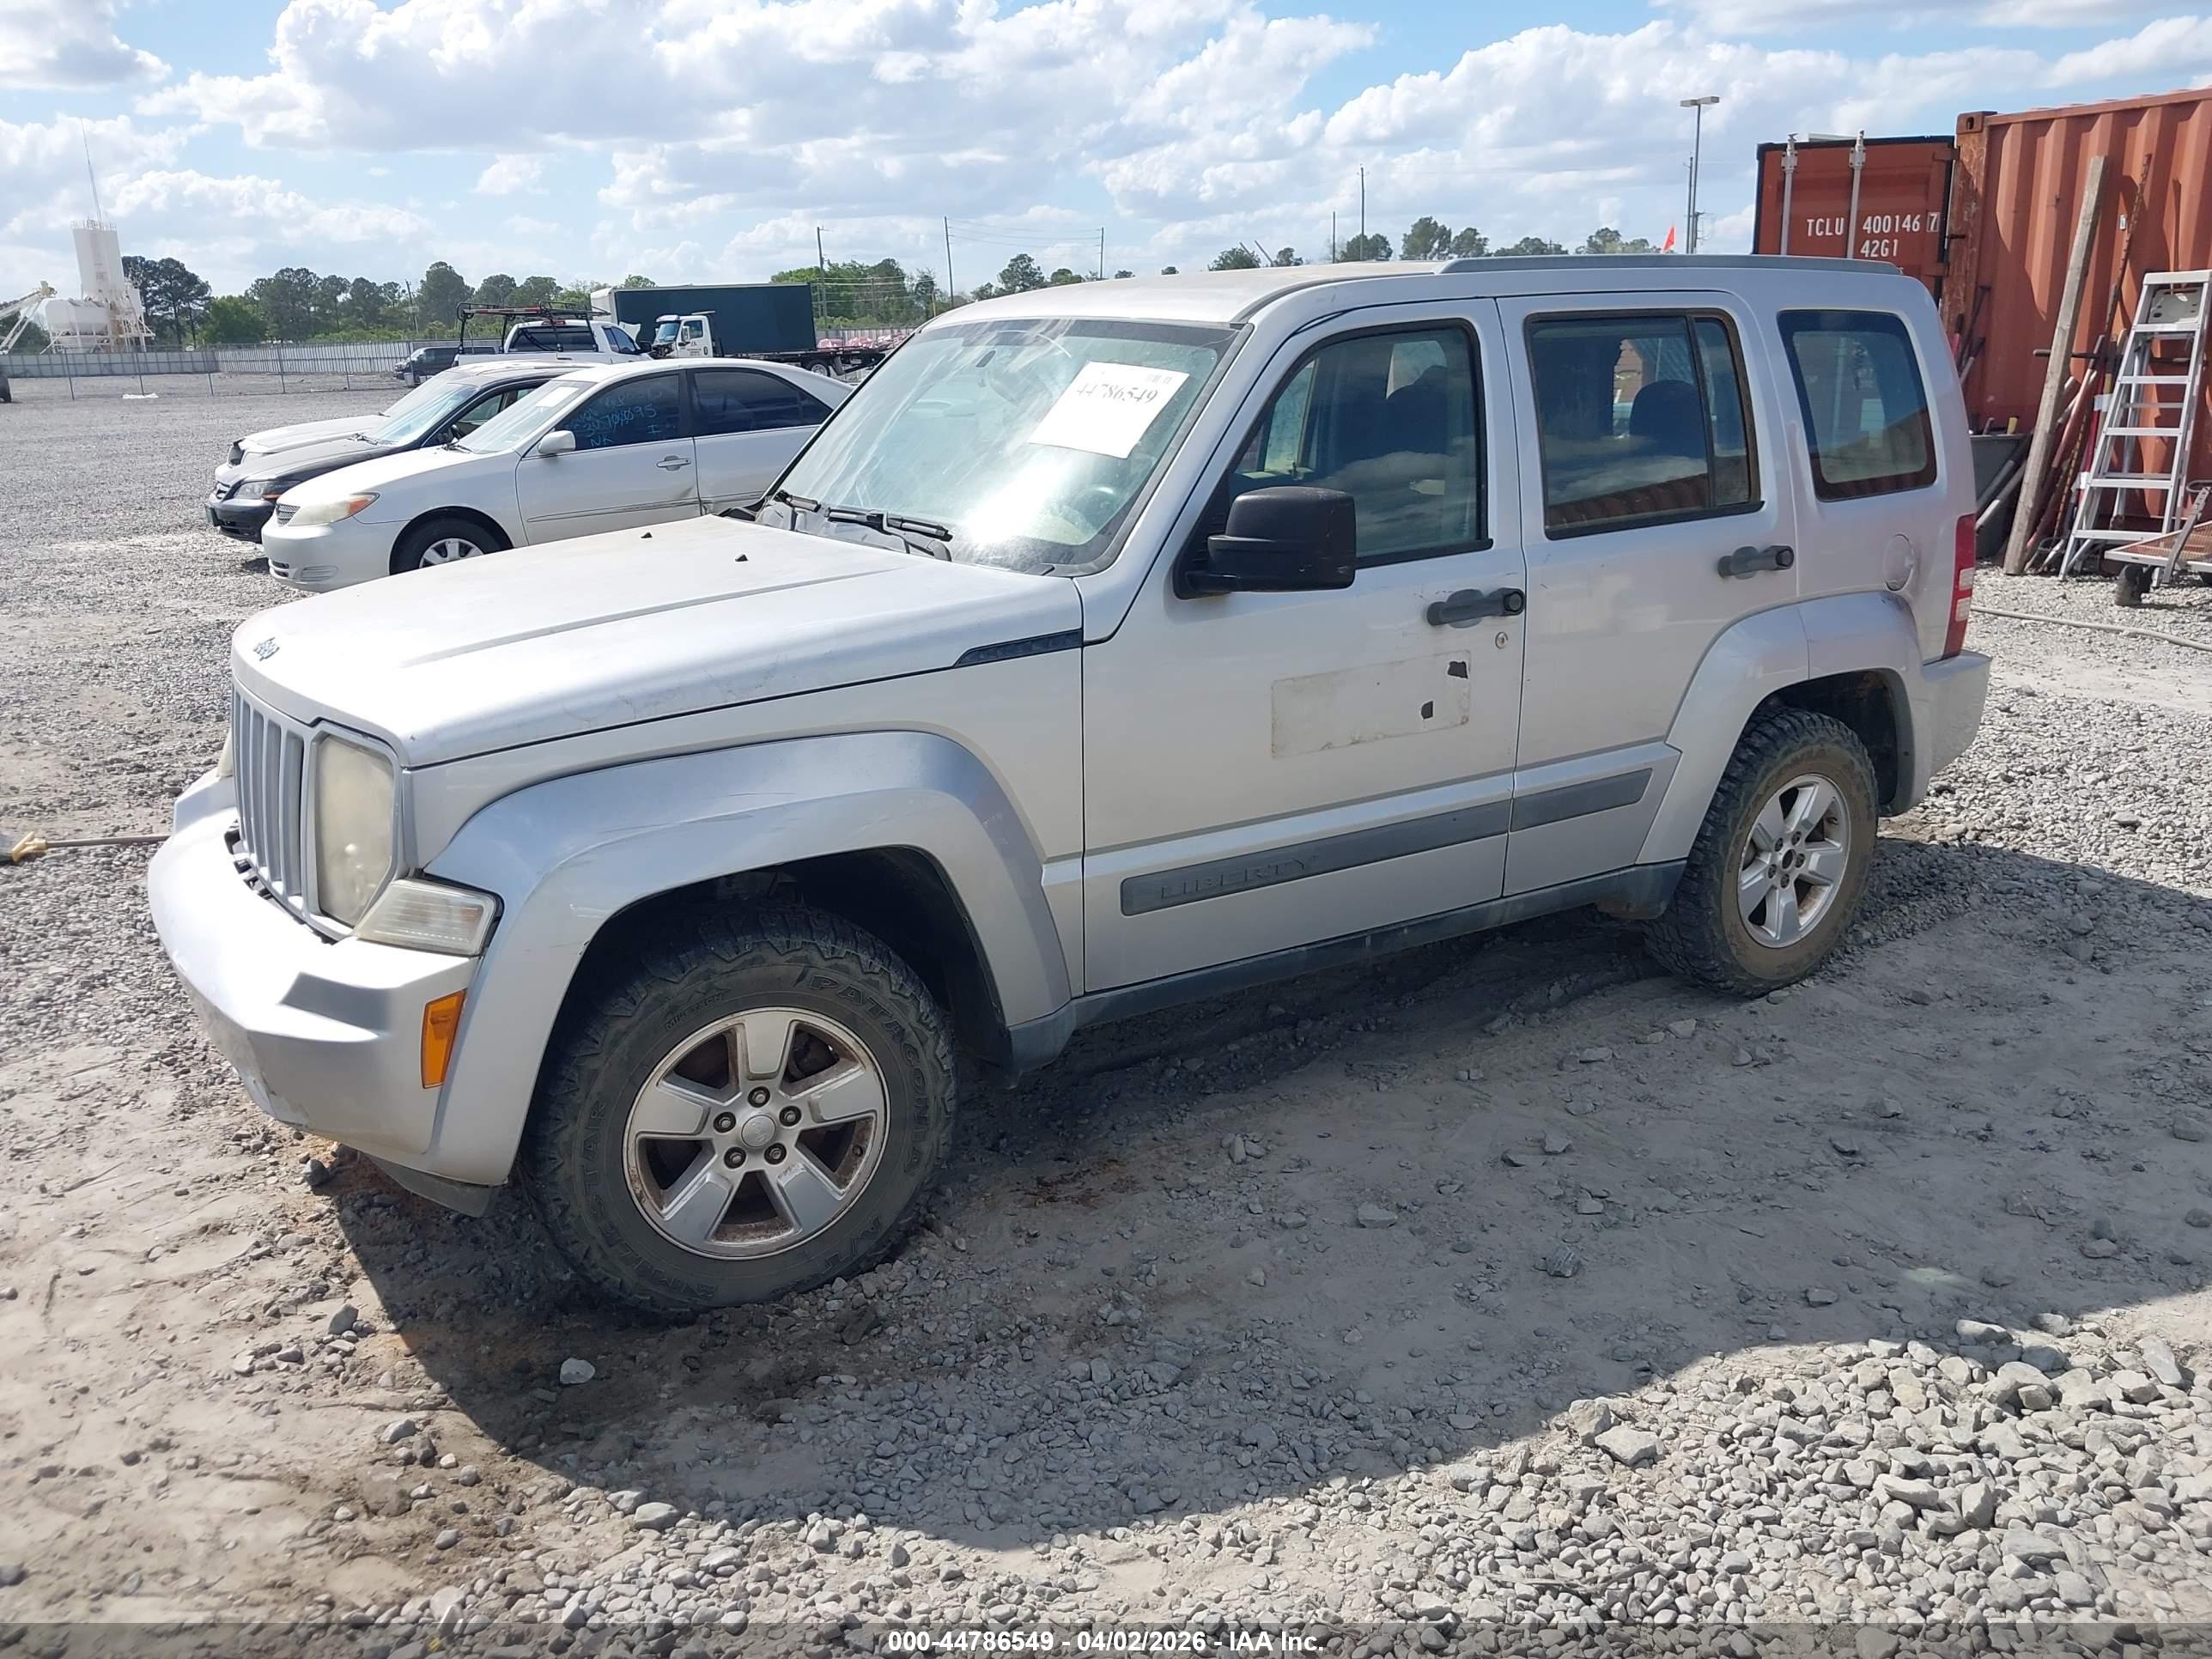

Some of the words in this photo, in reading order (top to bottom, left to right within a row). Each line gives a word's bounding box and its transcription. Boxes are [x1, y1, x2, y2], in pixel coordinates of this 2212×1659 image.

[1807, 217, 1844, 237] TCLU
[1862, 214, 1921, 234] 400146
[1860, 239, 1899, 258] 42G1
[1161, 859, 1306, 899] LIBERTY
